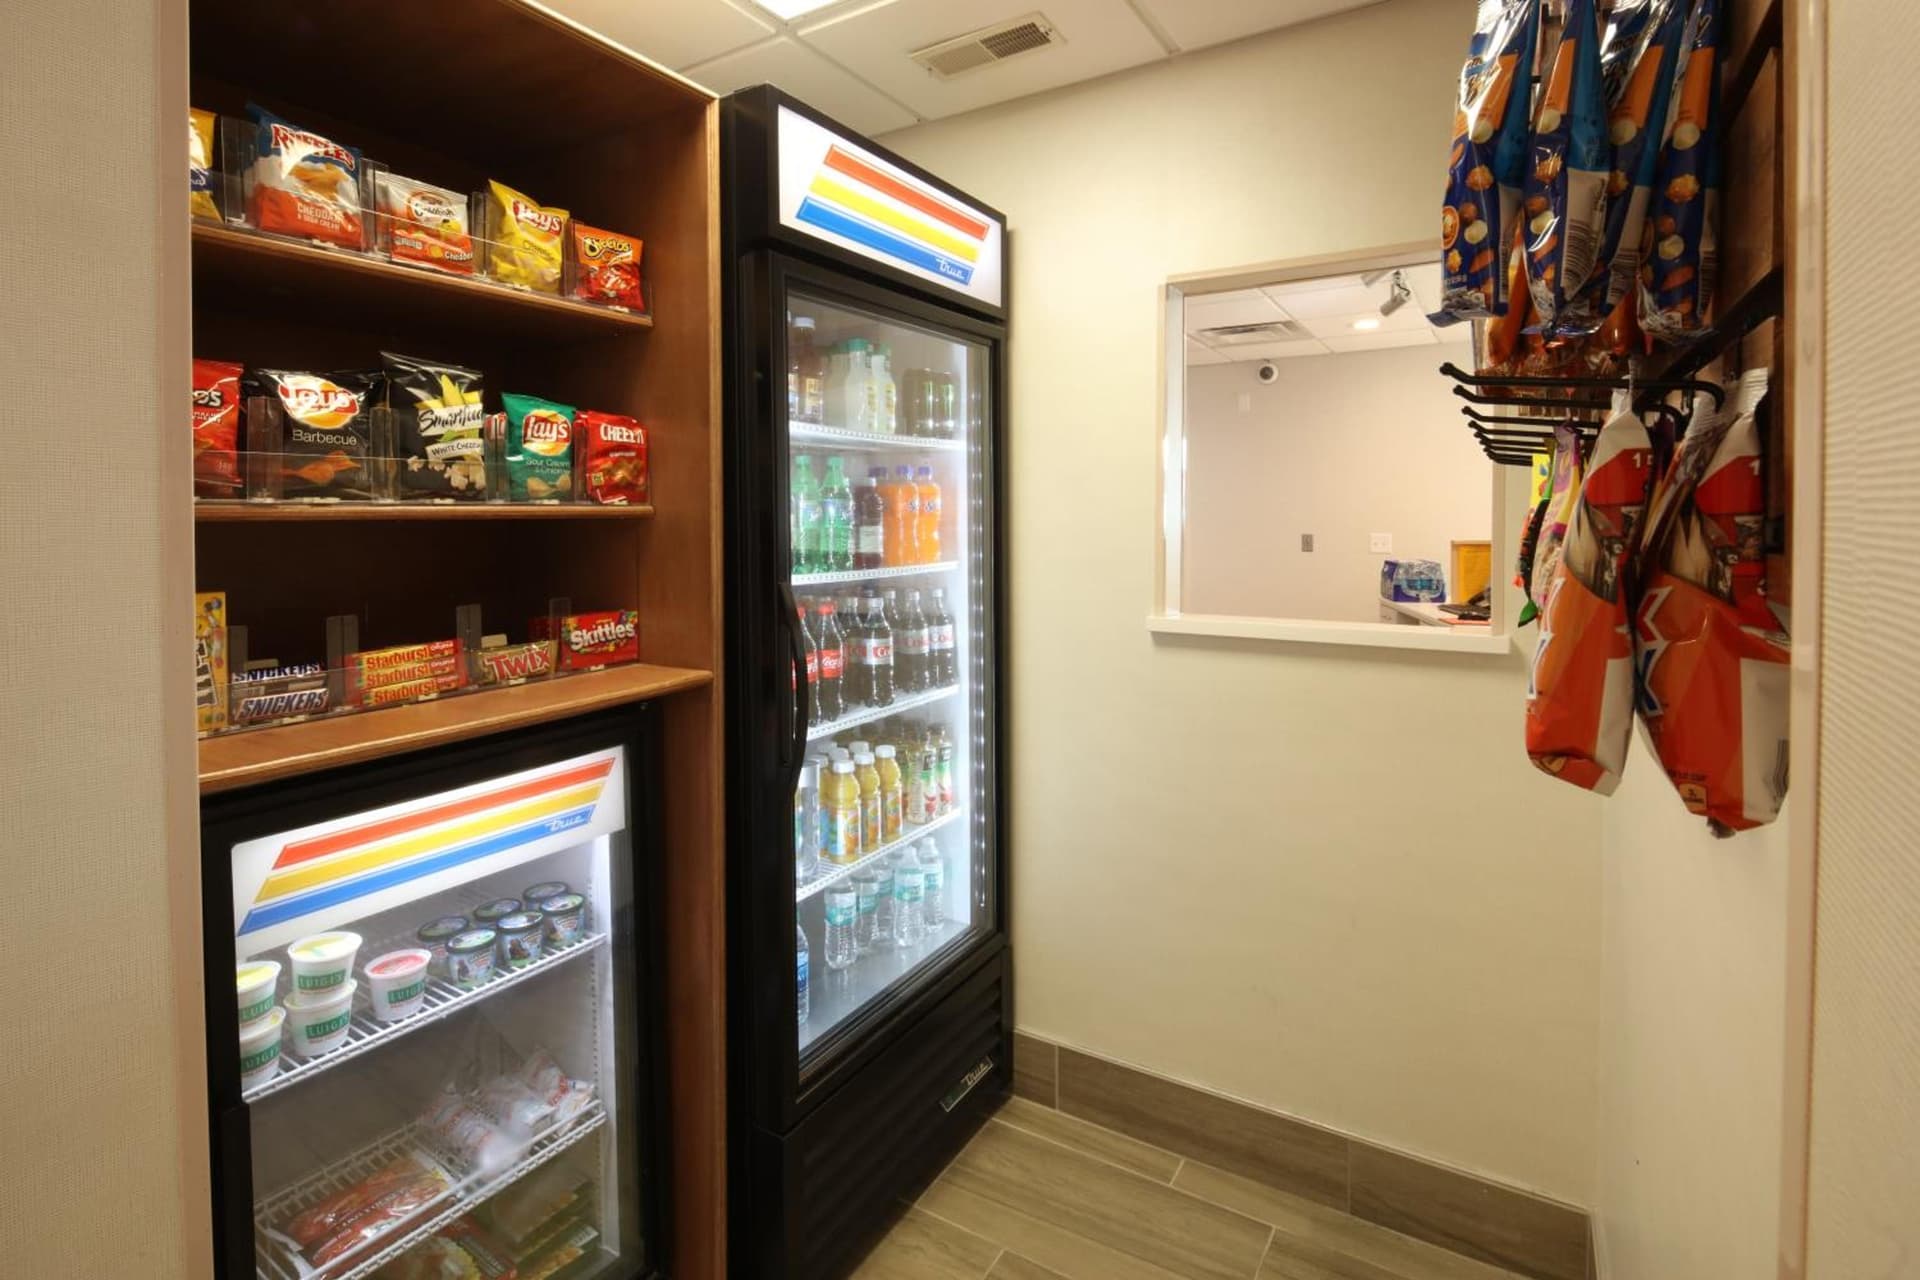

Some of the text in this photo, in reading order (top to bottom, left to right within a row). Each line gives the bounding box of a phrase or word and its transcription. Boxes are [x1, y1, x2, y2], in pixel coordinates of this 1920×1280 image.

[292, 429, 357, 446] Barbecue
[525, 416, 569, 443] Lay's
[570, 622, 635, 650] Skittles
[366, 646, 430, 670] Starburst
[232, 662, 322, 682] SNICKERS
[367, 663, 431, 687] Starburst
[374, 679, 437, 704] Starburst
[239, 691, 328, 717] SNICKERS
